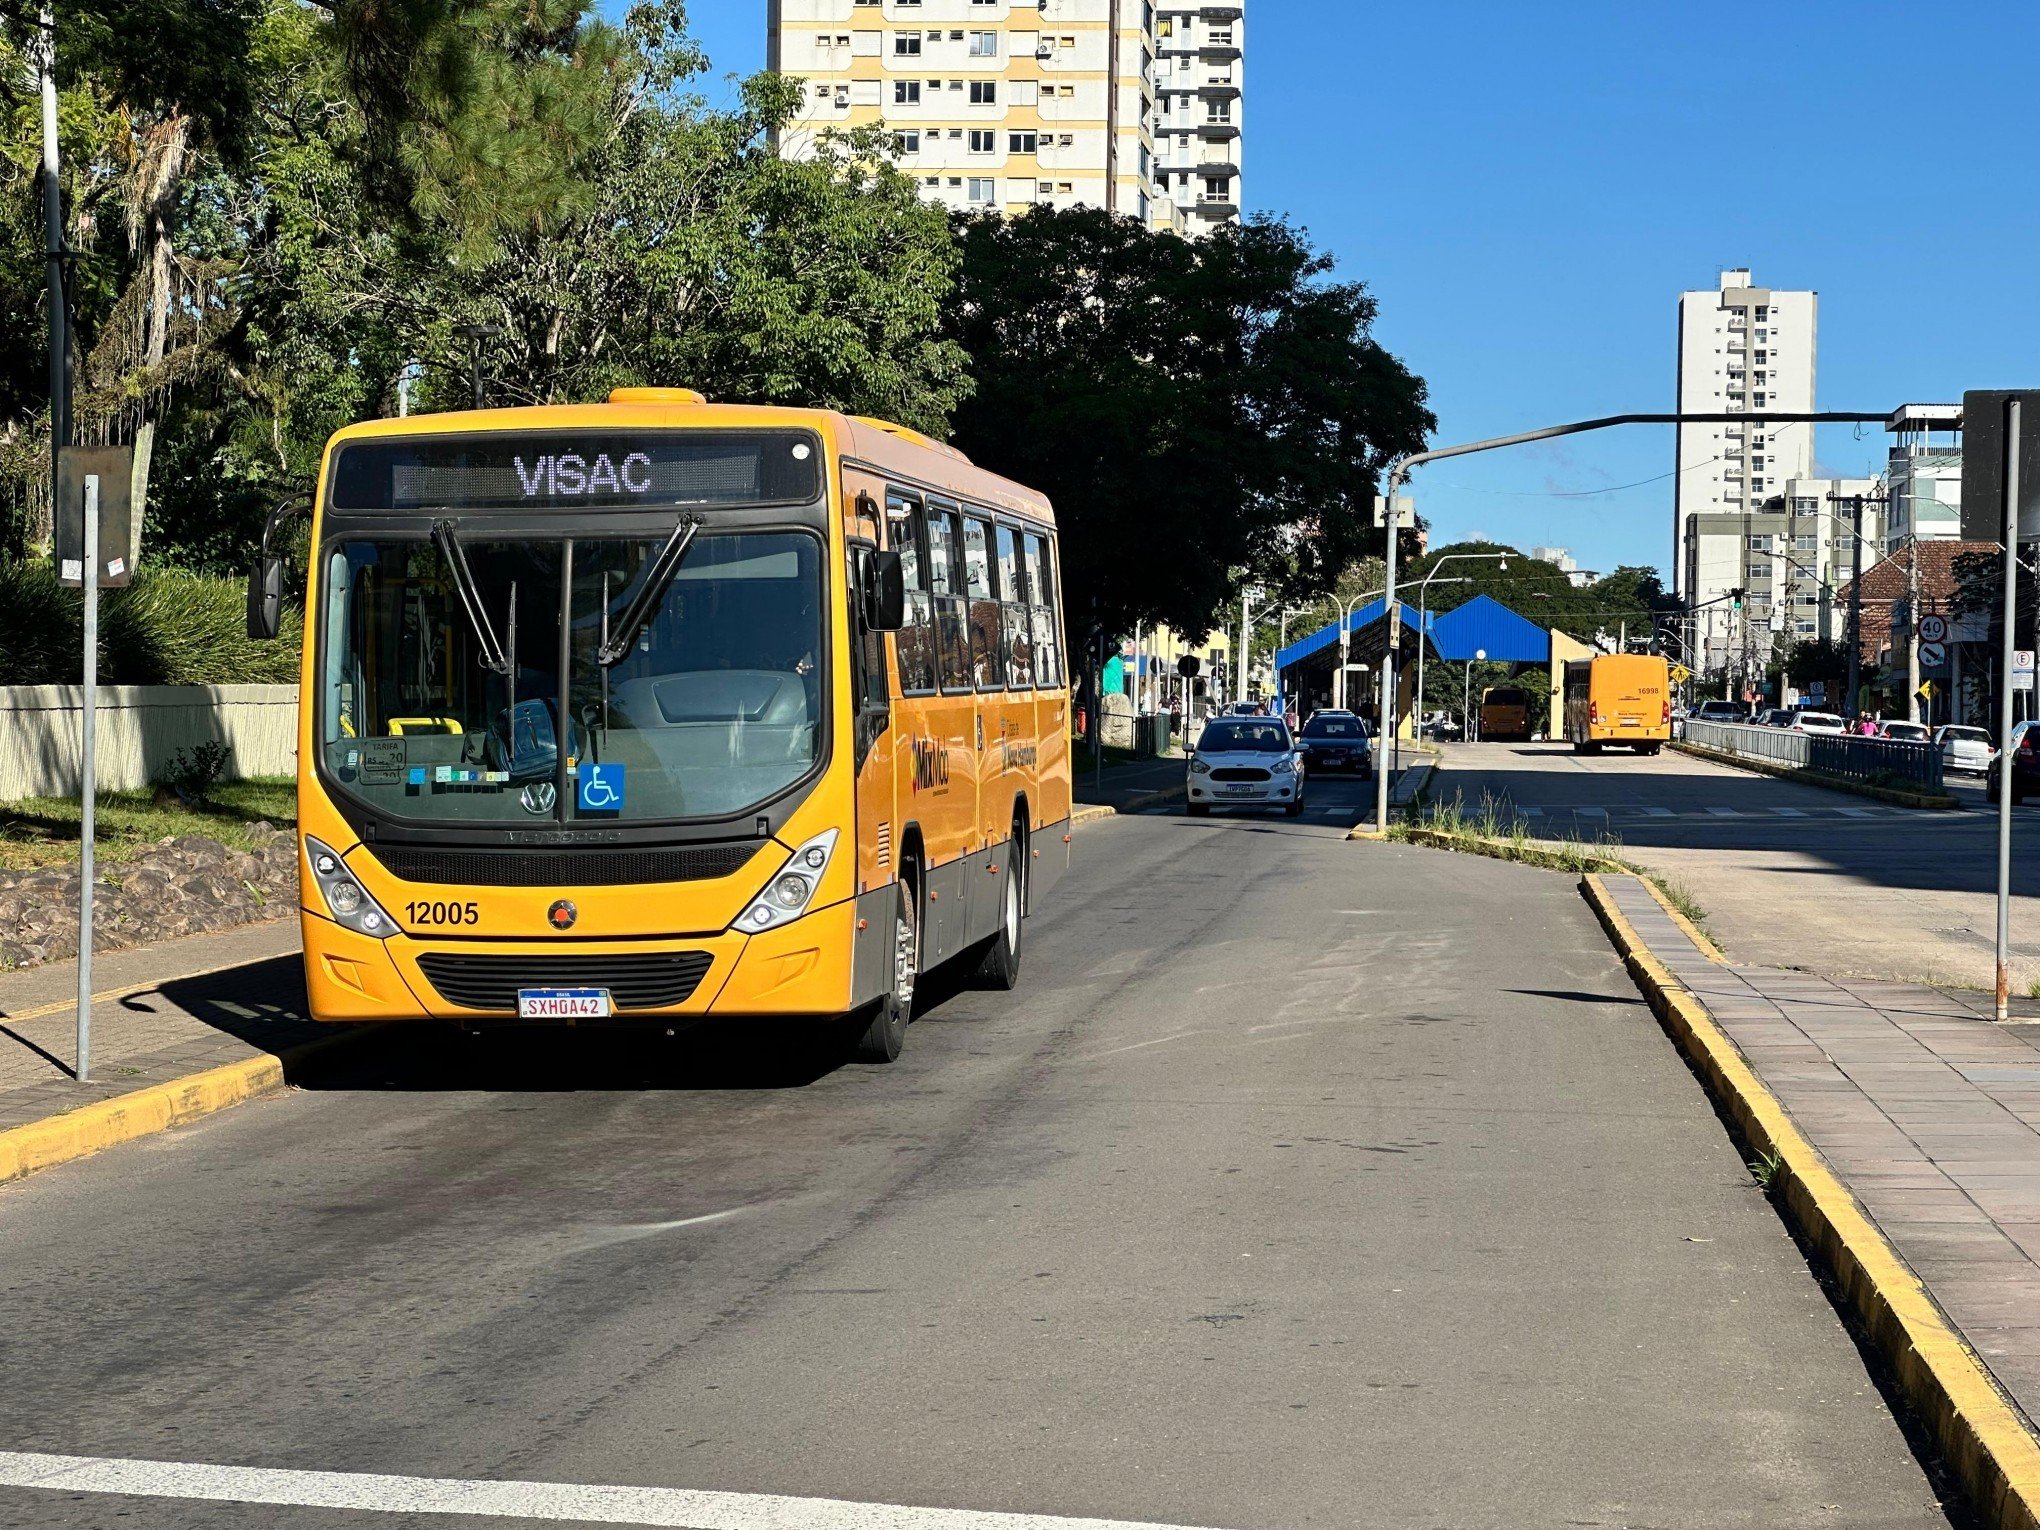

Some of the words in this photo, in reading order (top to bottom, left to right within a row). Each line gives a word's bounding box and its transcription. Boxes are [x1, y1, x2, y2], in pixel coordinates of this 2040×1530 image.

[514, 453, 651, 495] VISAC
[1922, 621, 1941, 634] 40
[2020, 654, 2026, 664] E
[373, 742, 399, 751] TARIFA
[405, 902, 479, 925] 12005
[528, 999, 599, 1015] SXH0A42
